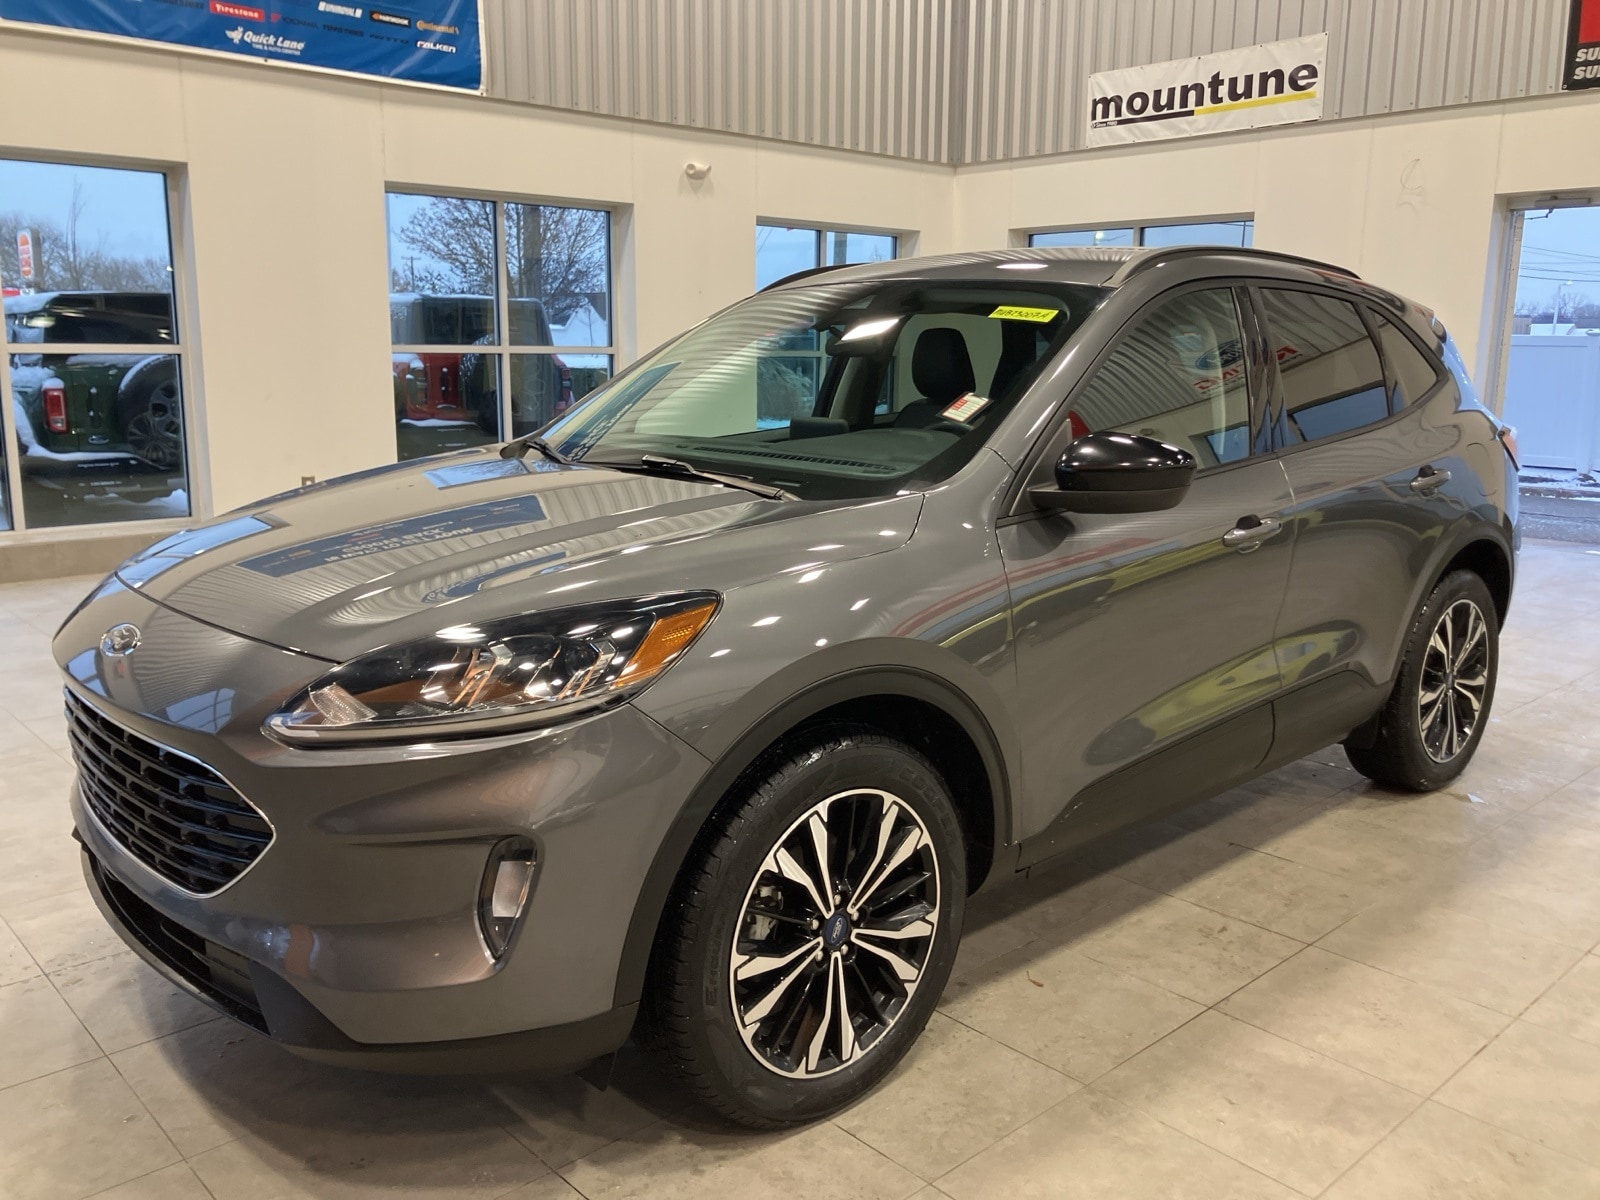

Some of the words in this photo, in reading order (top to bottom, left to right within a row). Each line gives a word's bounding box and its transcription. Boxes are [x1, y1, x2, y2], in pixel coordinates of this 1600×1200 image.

[215, 3, 259, 19] Firestone
[243, 30, 276, 45] Quick
[276, 36, 305, 50] Lane
[417, 40, 456, 53] FALKEN
[1575, 47, 1600, 62] SU
[1573, 65, 1600, 79] SU
[1091, 64, 1319, 121] mountune
